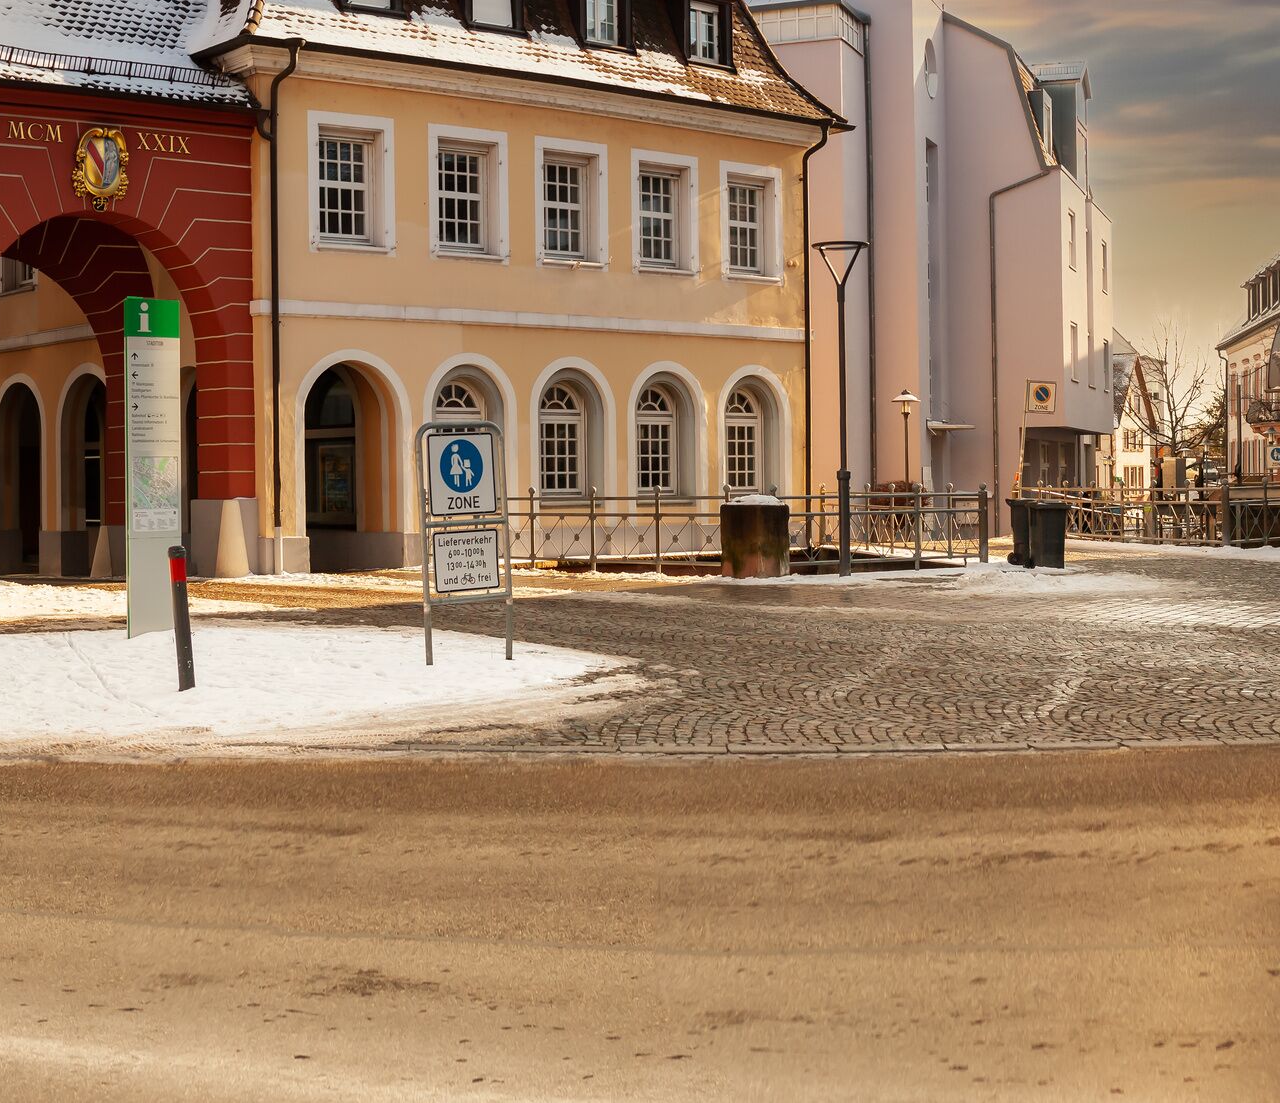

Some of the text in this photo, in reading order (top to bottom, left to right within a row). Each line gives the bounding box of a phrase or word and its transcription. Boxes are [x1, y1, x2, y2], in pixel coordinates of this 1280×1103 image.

[7, 120, 191, 154] MCM XXIX
[136, 302, 152, 333] i
[448, 496, 480, 509] ZONE
[438, 535, 493, 548] Lieferverkehr
[444, 573, 492, 585] und frei
